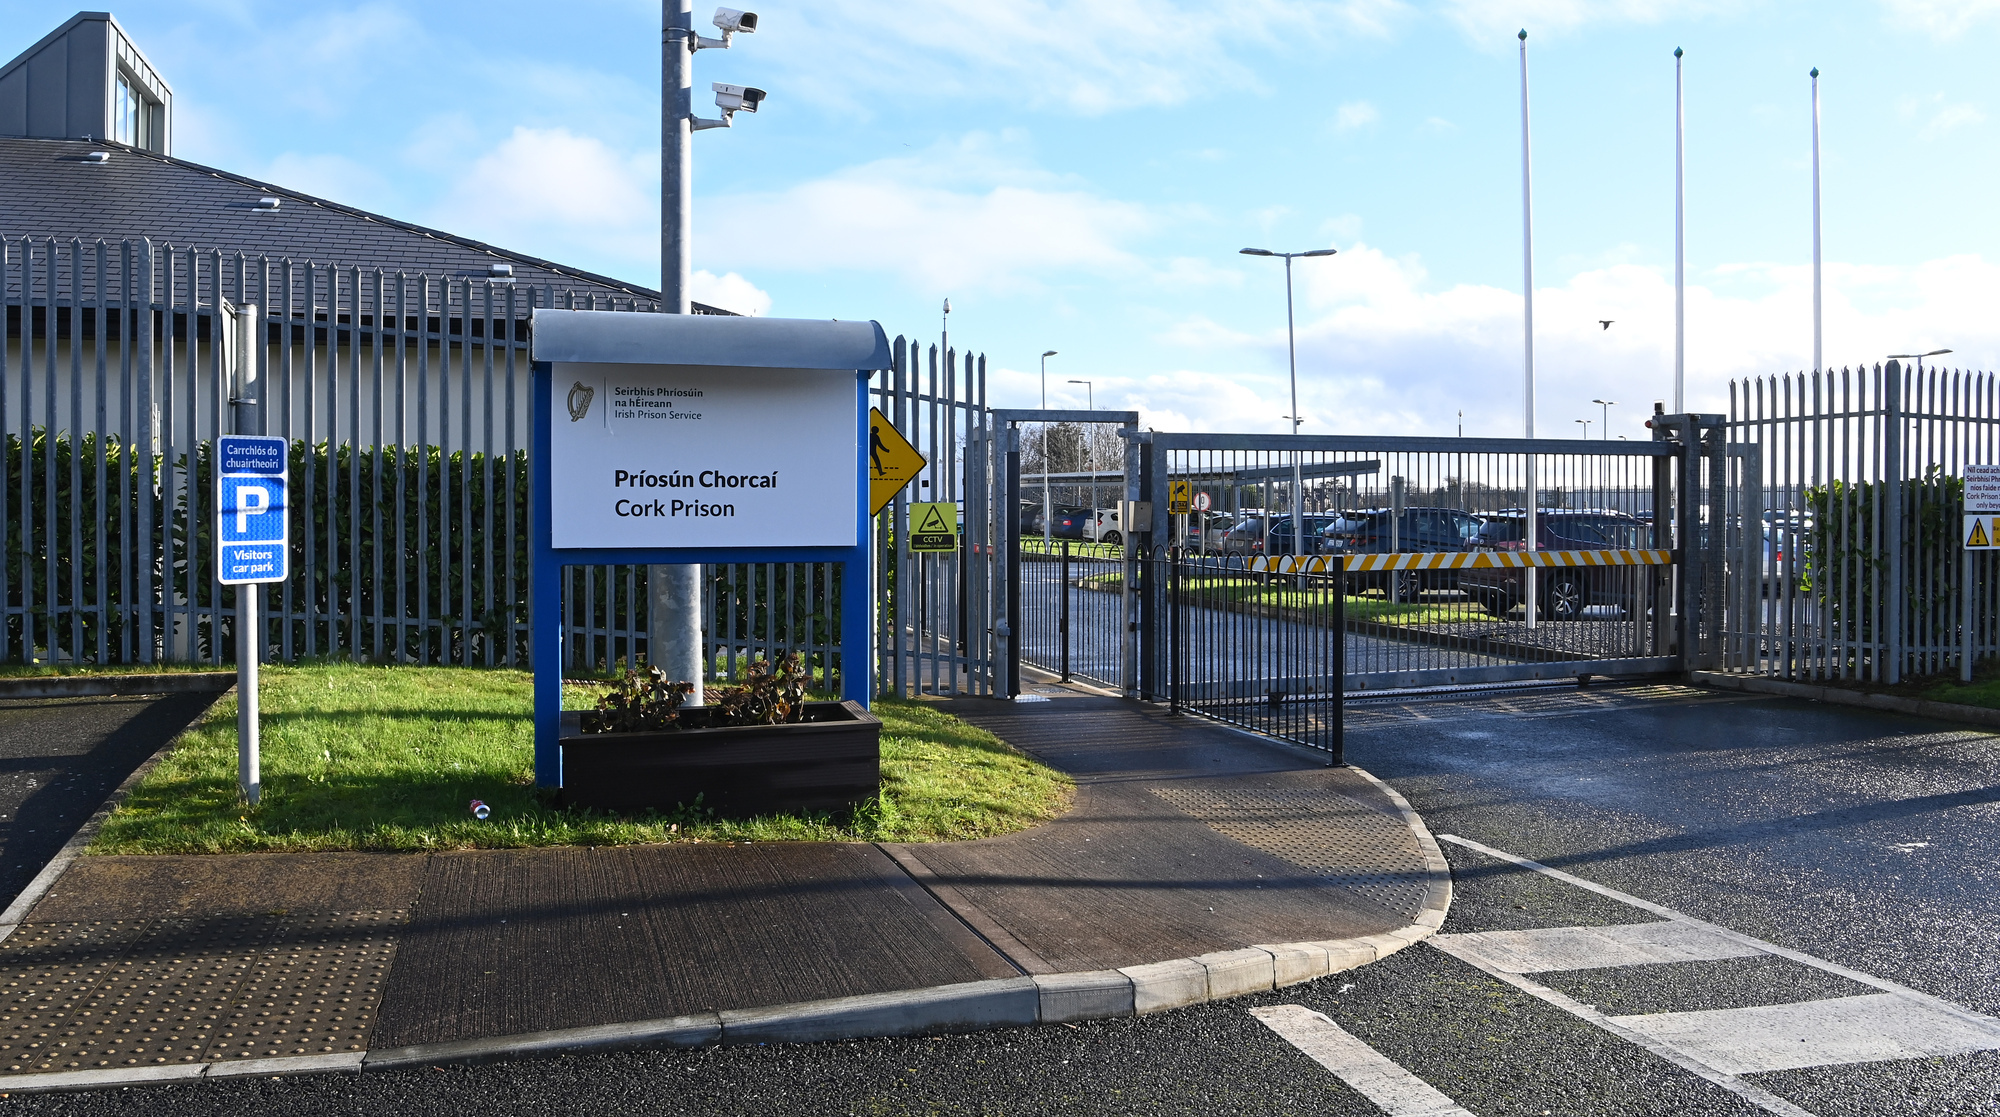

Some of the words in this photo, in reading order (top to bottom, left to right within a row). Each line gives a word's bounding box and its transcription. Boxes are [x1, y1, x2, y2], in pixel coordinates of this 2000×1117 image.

[614, 386, 655, 397] Seirbhís
[656, 387, 704, 398] Phríosúin
[614, 400, 627, 408] na
[629, 396, 672, 408] hÉireann
[614, 409, 635, 419] Irish
[637, 409, 667, 420] Prison
[669, 410, 702, 420] Service
[226, 444, 267, 456] Carrchlós
[267, 445, 278, 456] do
[225, 457, 279, 469] chuairtheoirí
[614, 469, 695, 488] Príosún
[698, 470, 779, 489] Chorcaí
[236, 485, 269, 533] P
[614, 498, 666, 517] Cork
[671, 499, 735, 517] Prison
[923, 535, 943, 543] CCTV
[233, 549, 273, 561] Visitors
[232, 564, 249, 573] car
[250, 561, 274, 575] park
